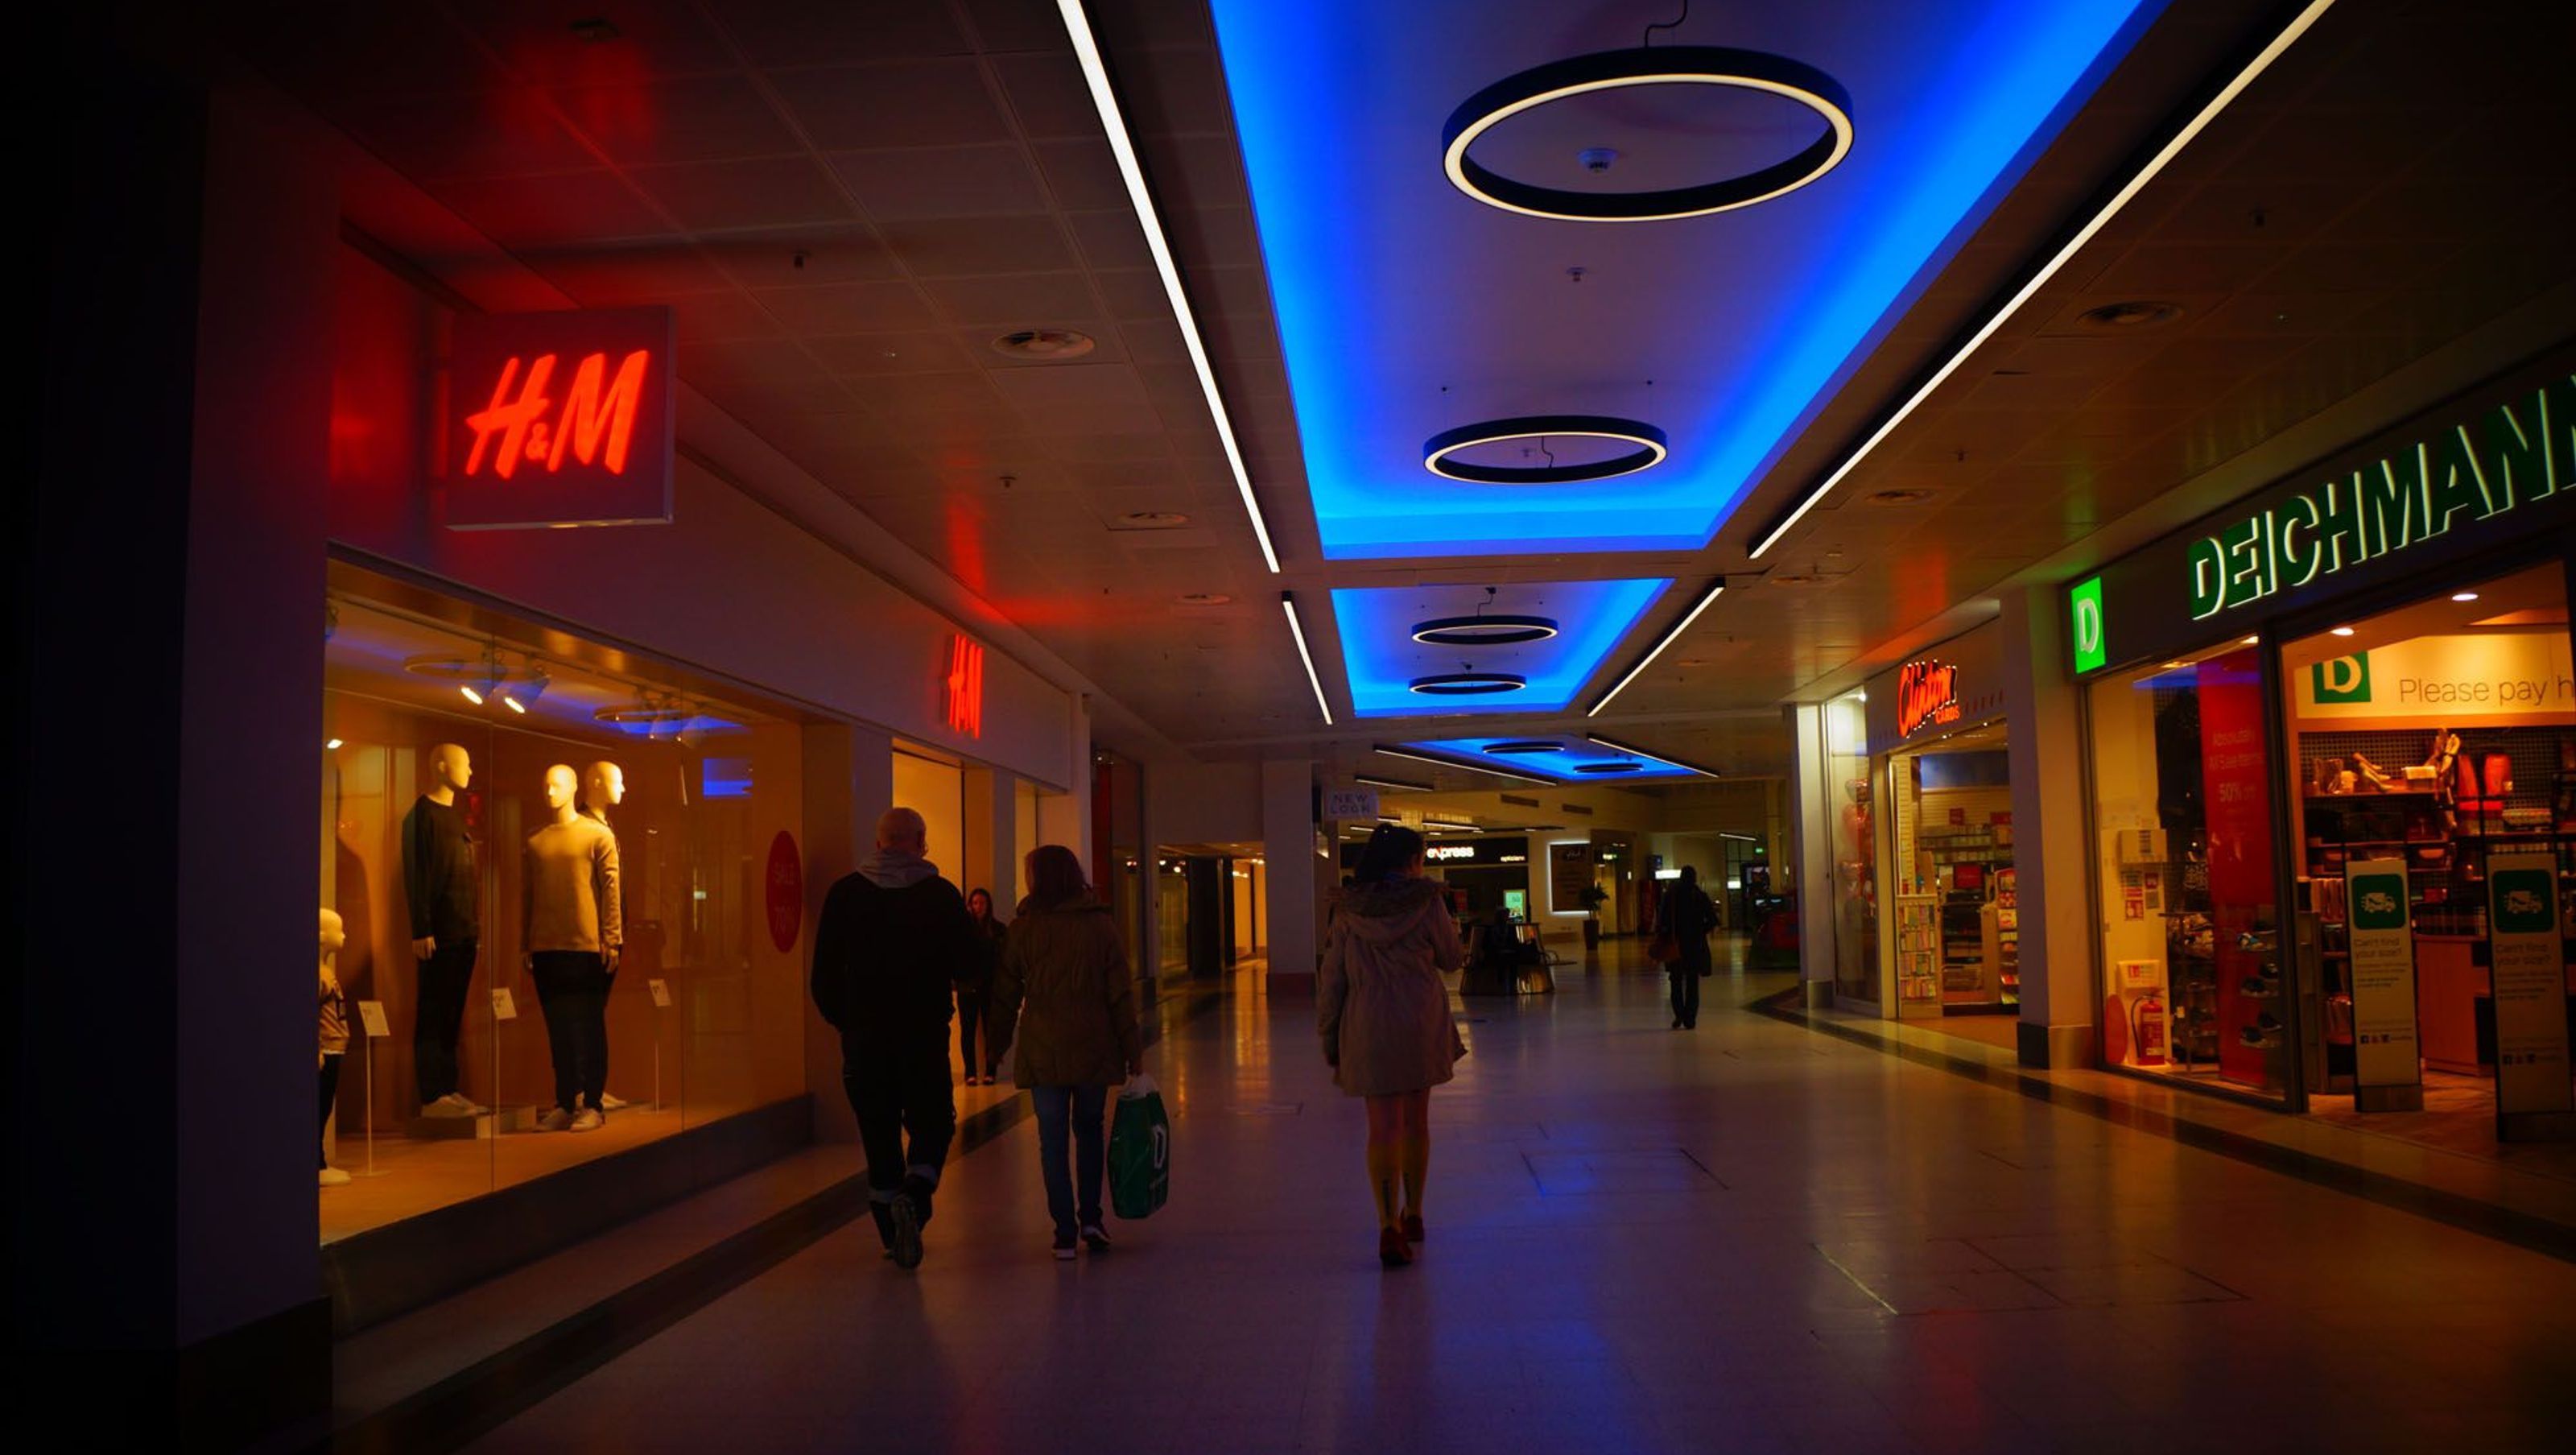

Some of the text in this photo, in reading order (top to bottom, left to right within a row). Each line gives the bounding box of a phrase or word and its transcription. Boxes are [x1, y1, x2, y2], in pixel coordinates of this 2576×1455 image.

[465, 349, 648, 480] H&M
[2077, 597, 2099, 654] D
[2322, 655, 2363, 693] D
[2400, 678, 2490, 703] Please
[2498, 679, 2549, 707] pay
[1331, 804, 1370, 814] LOOK
[1334, 793, 1368, 802] NEW
